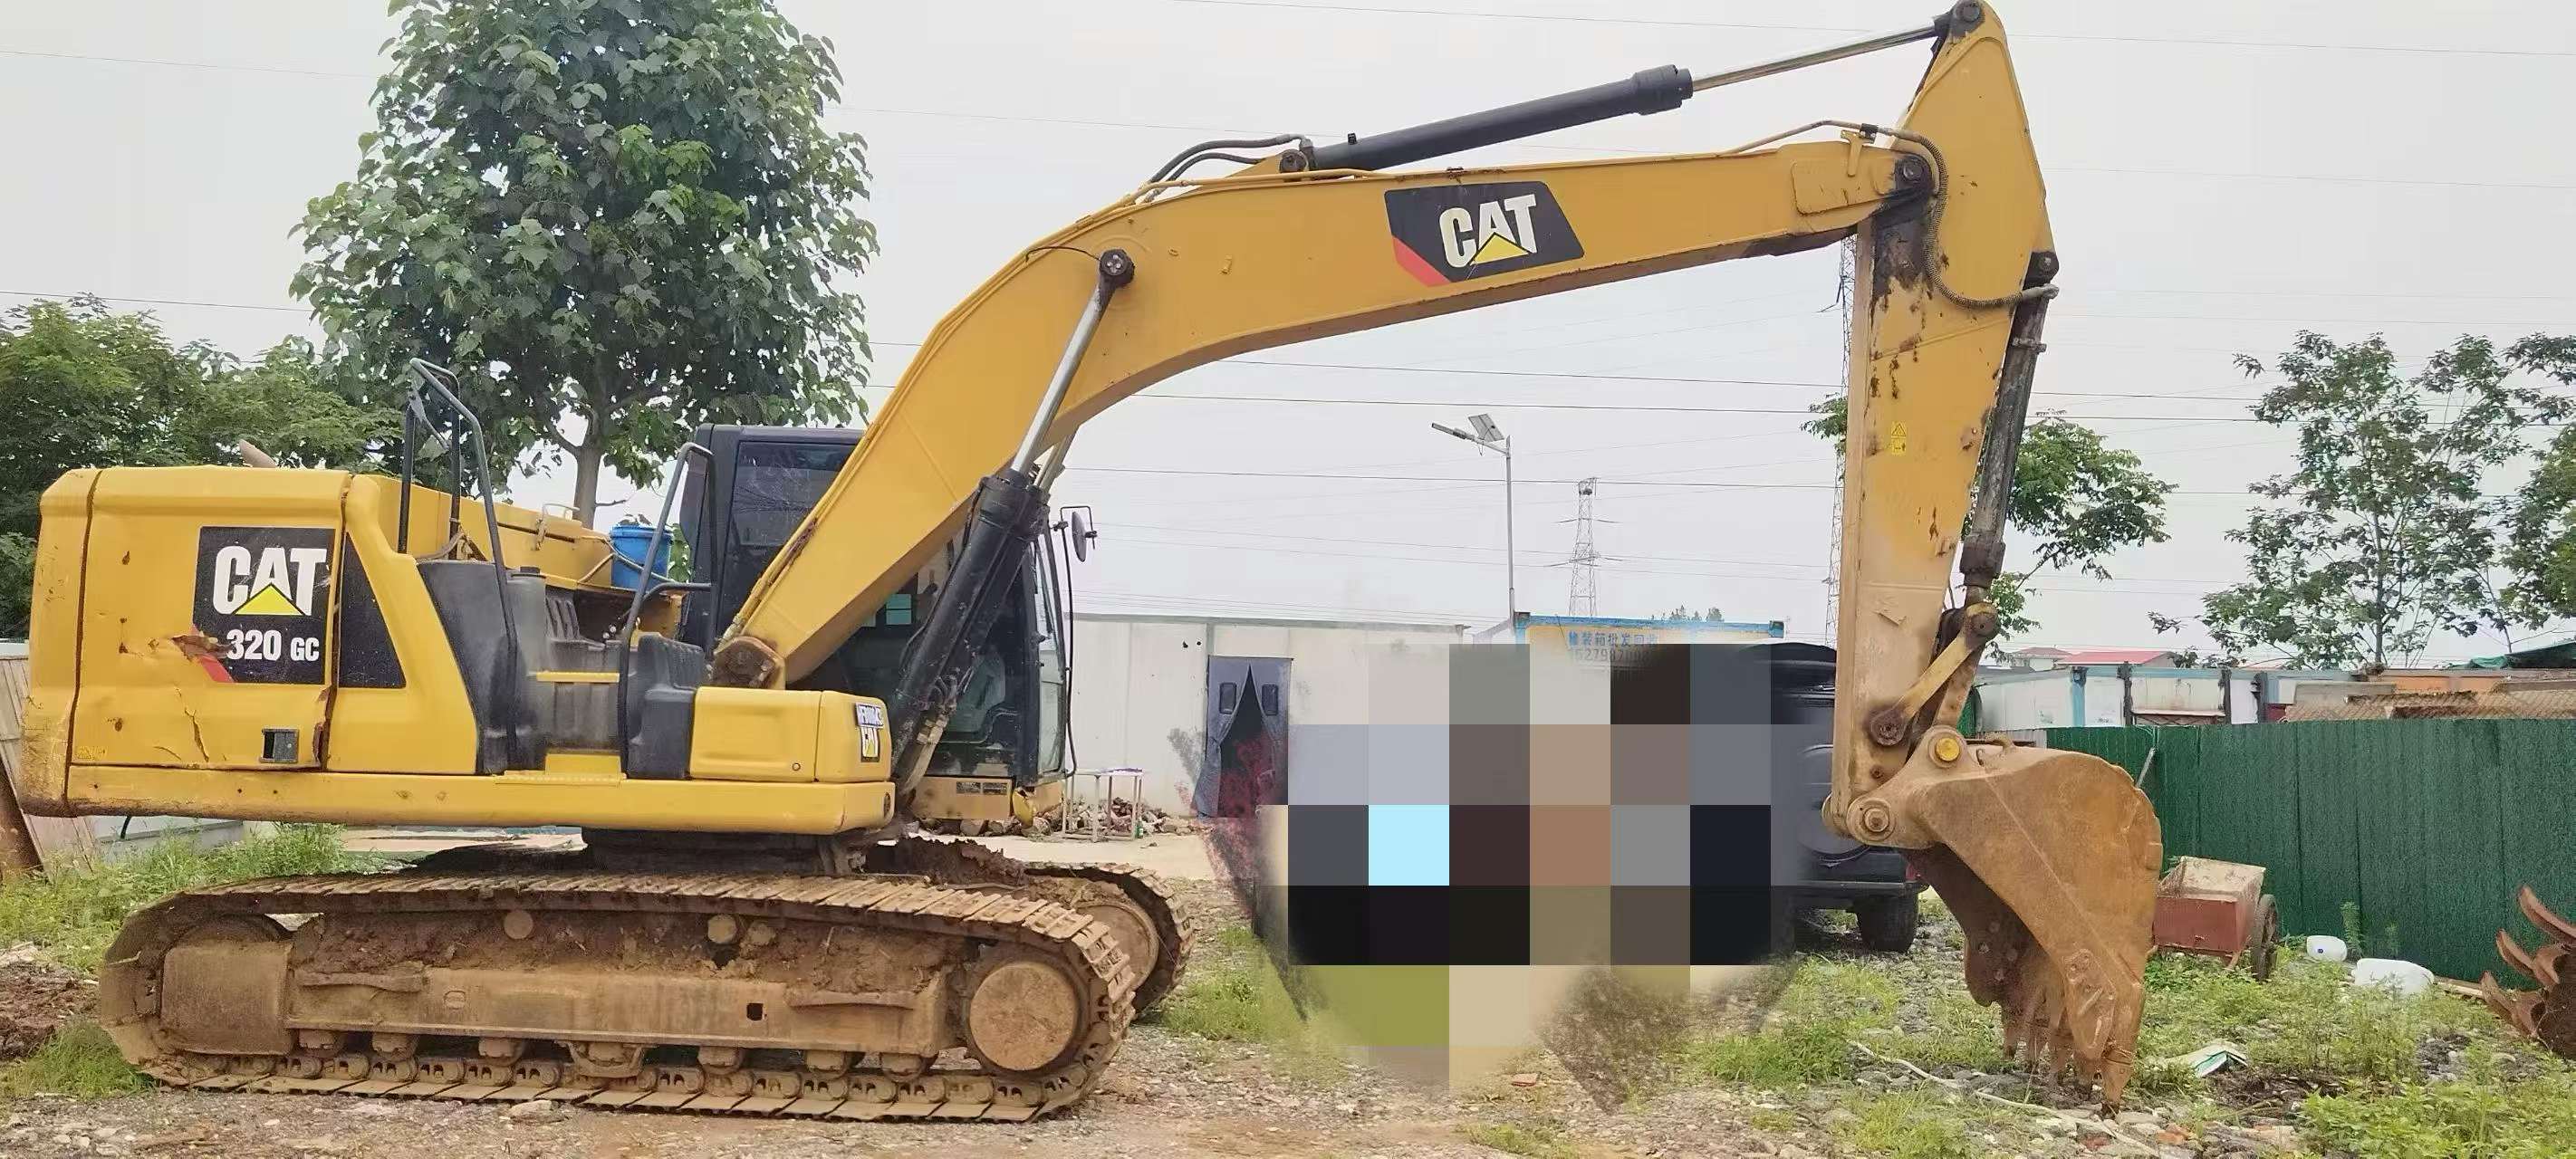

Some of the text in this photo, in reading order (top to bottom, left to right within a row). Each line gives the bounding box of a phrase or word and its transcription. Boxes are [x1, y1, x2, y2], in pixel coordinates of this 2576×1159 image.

[1439, 194, 1537, 268] CAT
[213, 545, 327, 616] CAT
[226, 628, 320, 662] 320 GC
